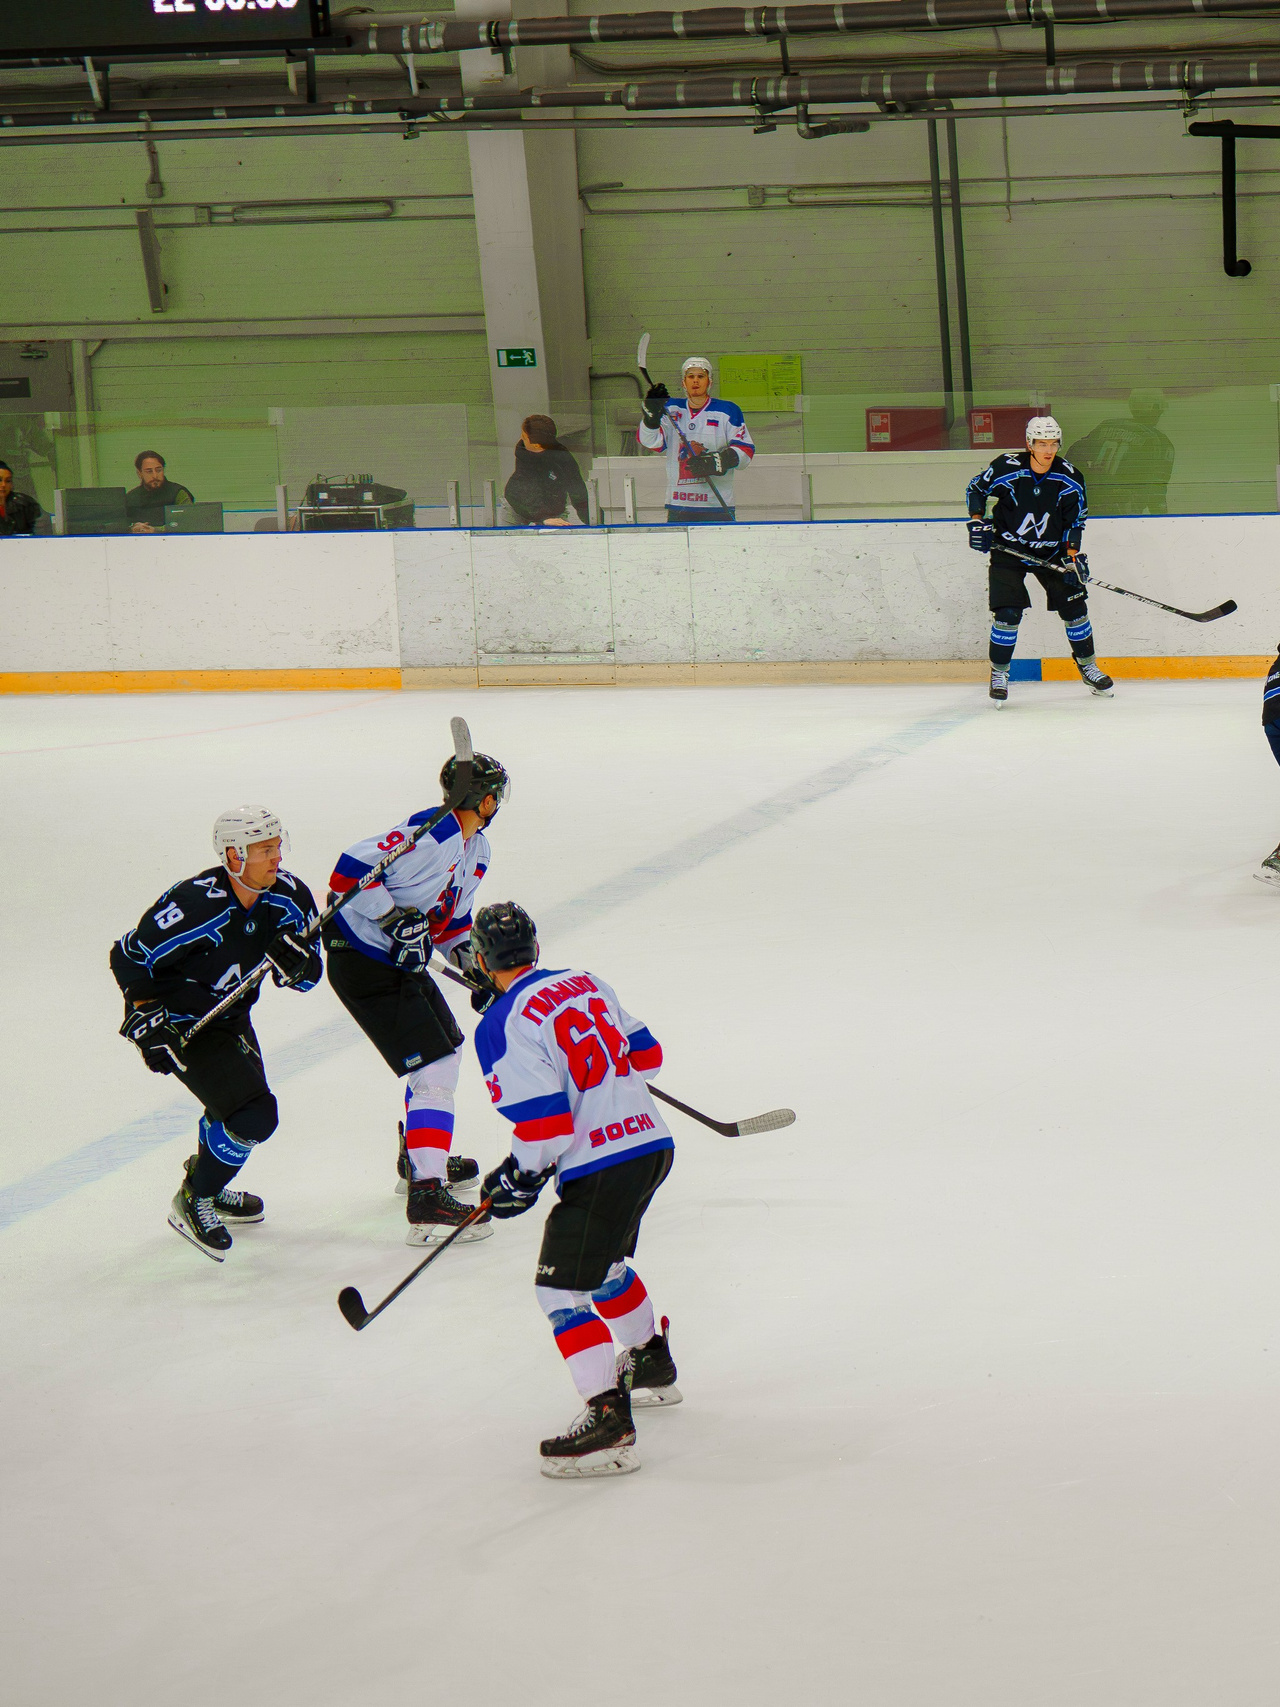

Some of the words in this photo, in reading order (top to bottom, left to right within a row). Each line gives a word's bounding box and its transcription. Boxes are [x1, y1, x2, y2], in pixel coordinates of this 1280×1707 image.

[673, 491, 708, 502] SOCHI
[382, 833, 415, 867] TIMER
[153, 901, 185, 930] 19
[554, 997, 630, 1092] 66
[589, 1113, 656, 1149] SOCHI
